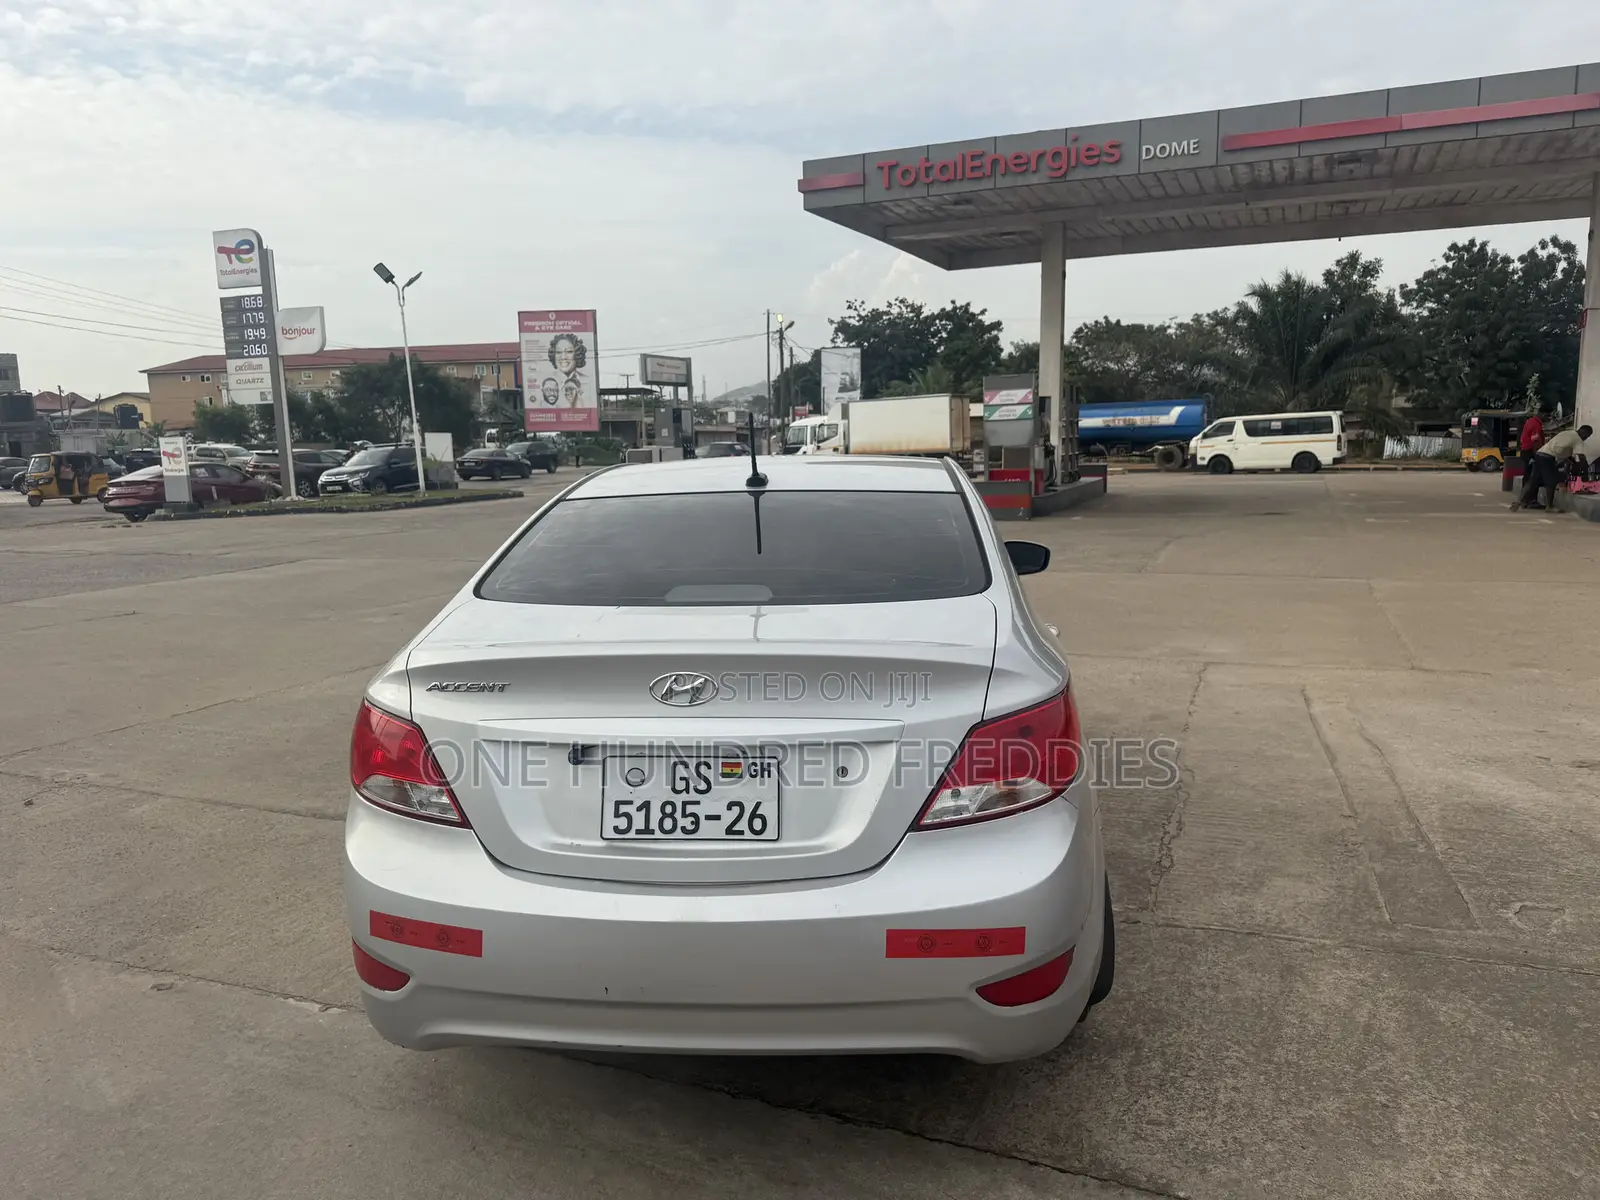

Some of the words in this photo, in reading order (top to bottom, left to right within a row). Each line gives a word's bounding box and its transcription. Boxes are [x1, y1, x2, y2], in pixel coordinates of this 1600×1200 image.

[876, 134, 1122, 190] TotalEnergies
[1141, 138, 1200, 161] DOME
[219, 266, 258, 276] TotalEnergies
[243, 312, 265, 324] 17.79
[281, 325, 316, 337] bonjour
[425, 681, 511, 693] ACCENT
[670, 760, 713, 795] GS
[747, 761, 772, 779] GH
[612, 799, 768, 836] 5185-26
